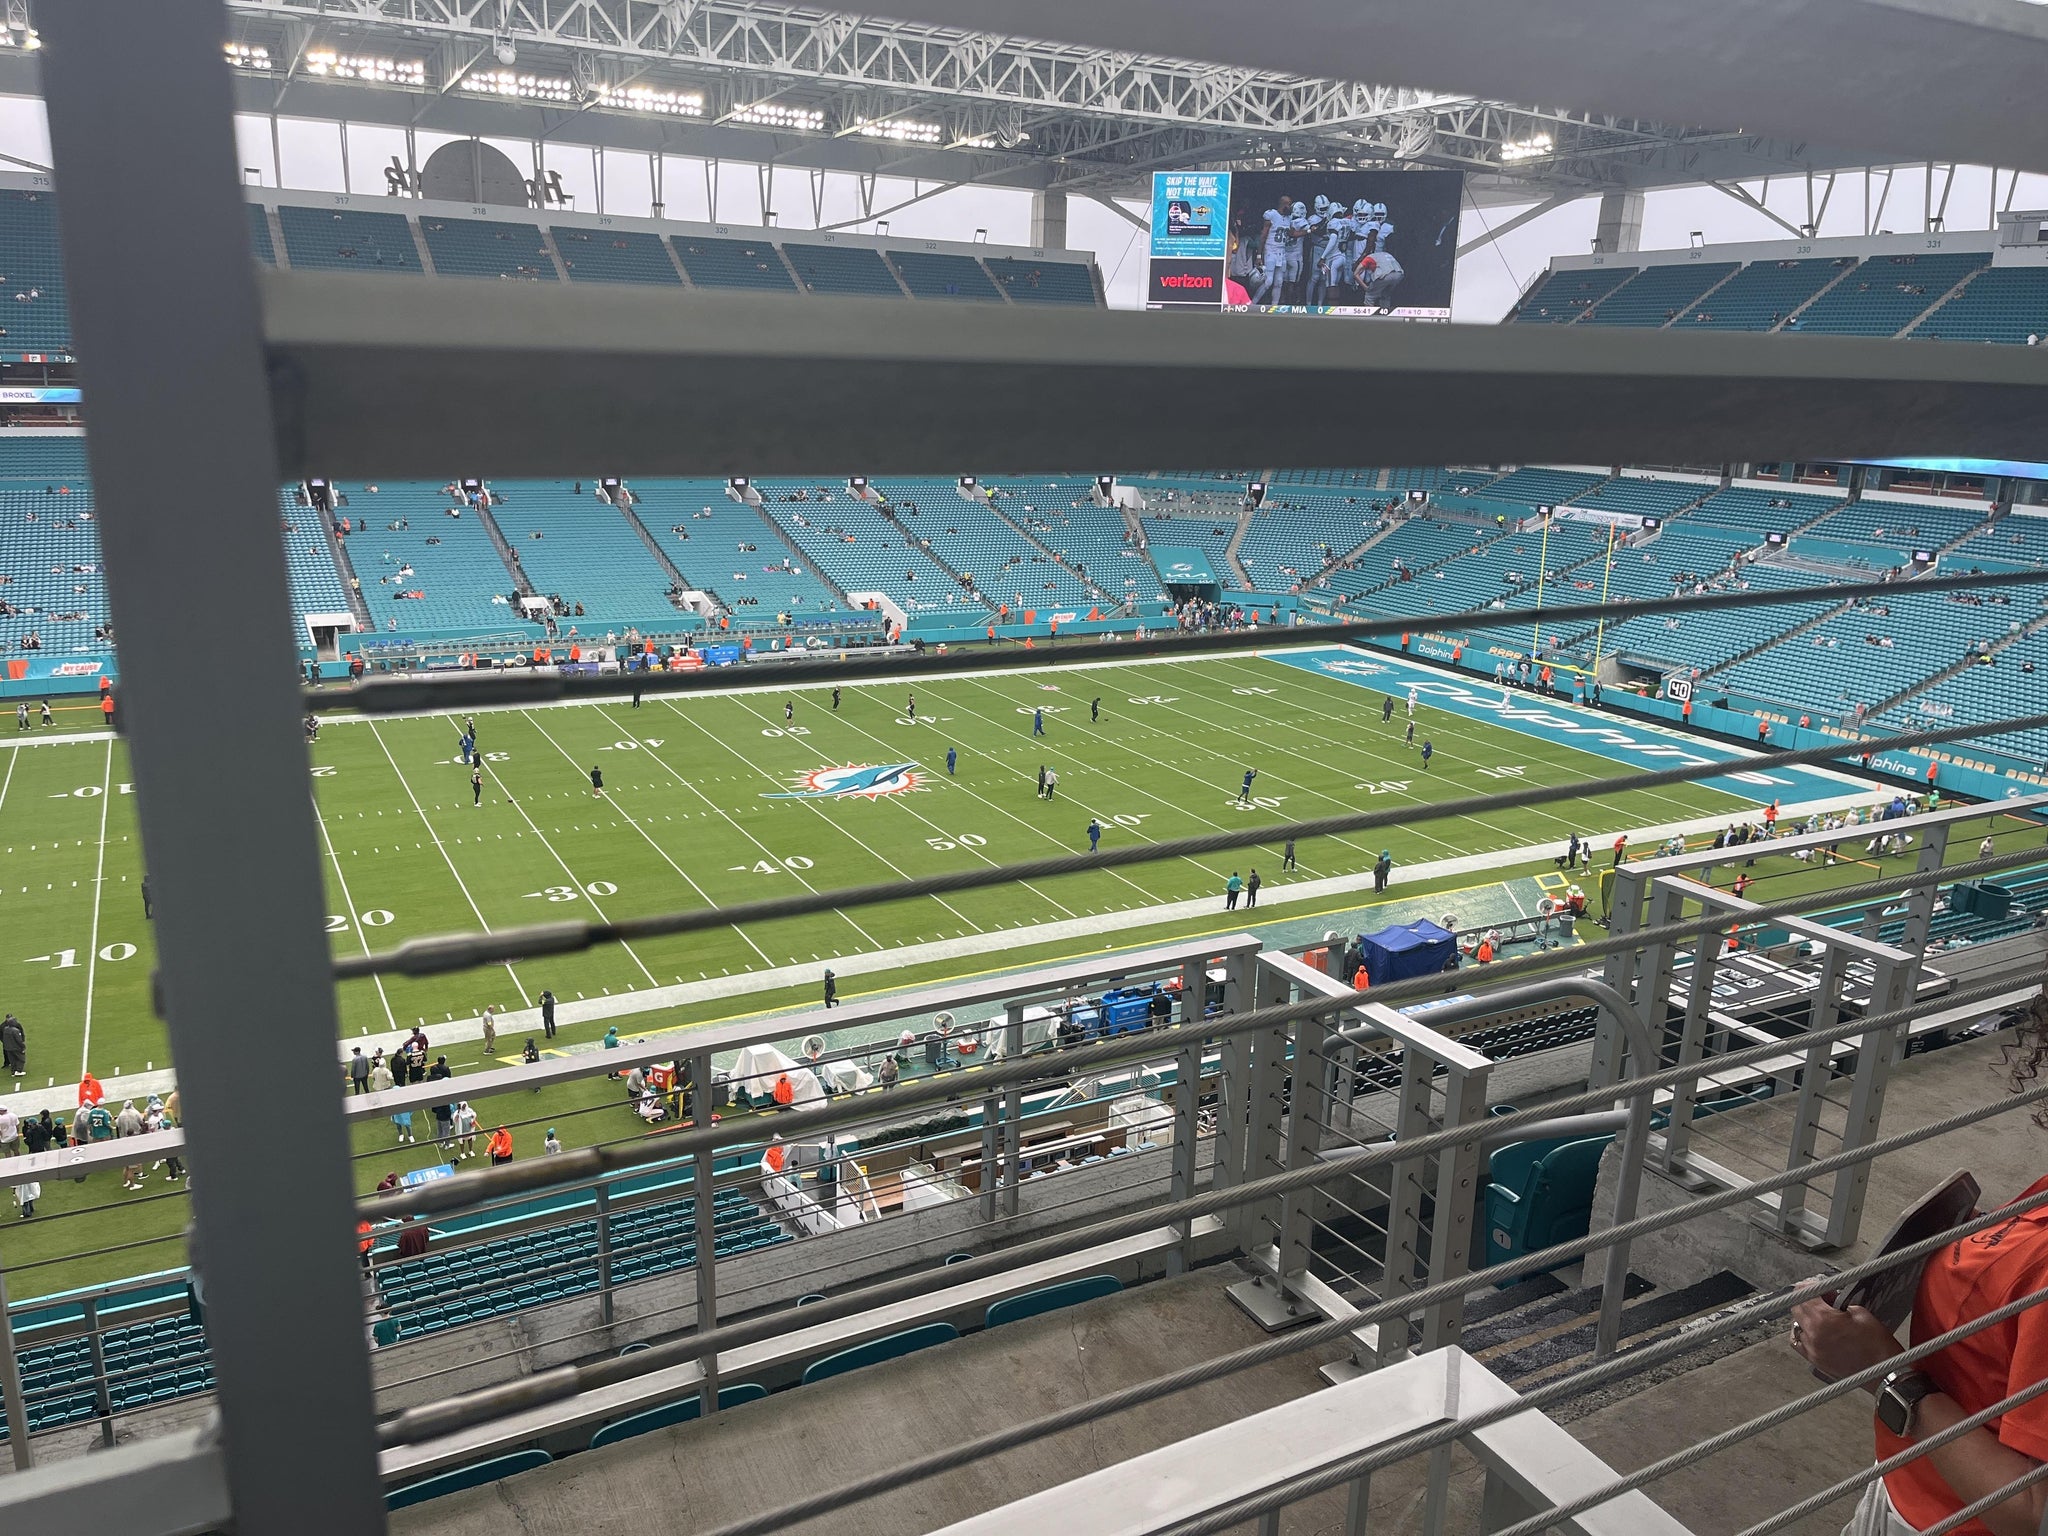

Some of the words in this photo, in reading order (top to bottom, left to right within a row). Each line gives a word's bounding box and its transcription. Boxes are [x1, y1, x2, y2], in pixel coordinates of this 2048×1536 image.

[32, 177, 49, 186] 315
[1166, 177, 1183, 186] SKIP
[1184, 177, 1197, 186] THE
[1166, 187, 1181, 197] NOT
[1183, 187, 1196, 197] THE
[1197, 187, 1218, 197] GAME
[334, 196, 349, 205] 317
[472, 207, 487, 216] 318
[598, 217, 613, 226] 319
[715, 226, 729, 235] 320
[823, 234, 836, 243] 321
[925, 242, 937, 250] 322
[1926, 240, 1942, 249] 331
[1033, 250, 1045, 258] 323
[1797, 246, 1811, 254] 330
[1689, 251, 1703, 260] 329
[1593, 257, 1605, 265] 328
[1160, 273, 1213, 288] verizon
[1235, 305, 1249, 313] NO
[1291, 306, 1308, 314] MIA
[75, 664, 98, 672] CAUSE
[1671, 682, 1689, 698] 40
[1474, 766, 1524, 779] 10
[1354, 779, 1409, 795] 20
[1224, 796, 1282, 813] 30
[925, 833, 988, 851] 50
[750, 855, 815, 876] 40
[543, 881, 618, 903] 30
[325, 909, 395, 933] 20
[51, 942, 138, 970] 10
[654, 1072, 664, 1083] G
[1499, 1233, 1504, 1244] 1
